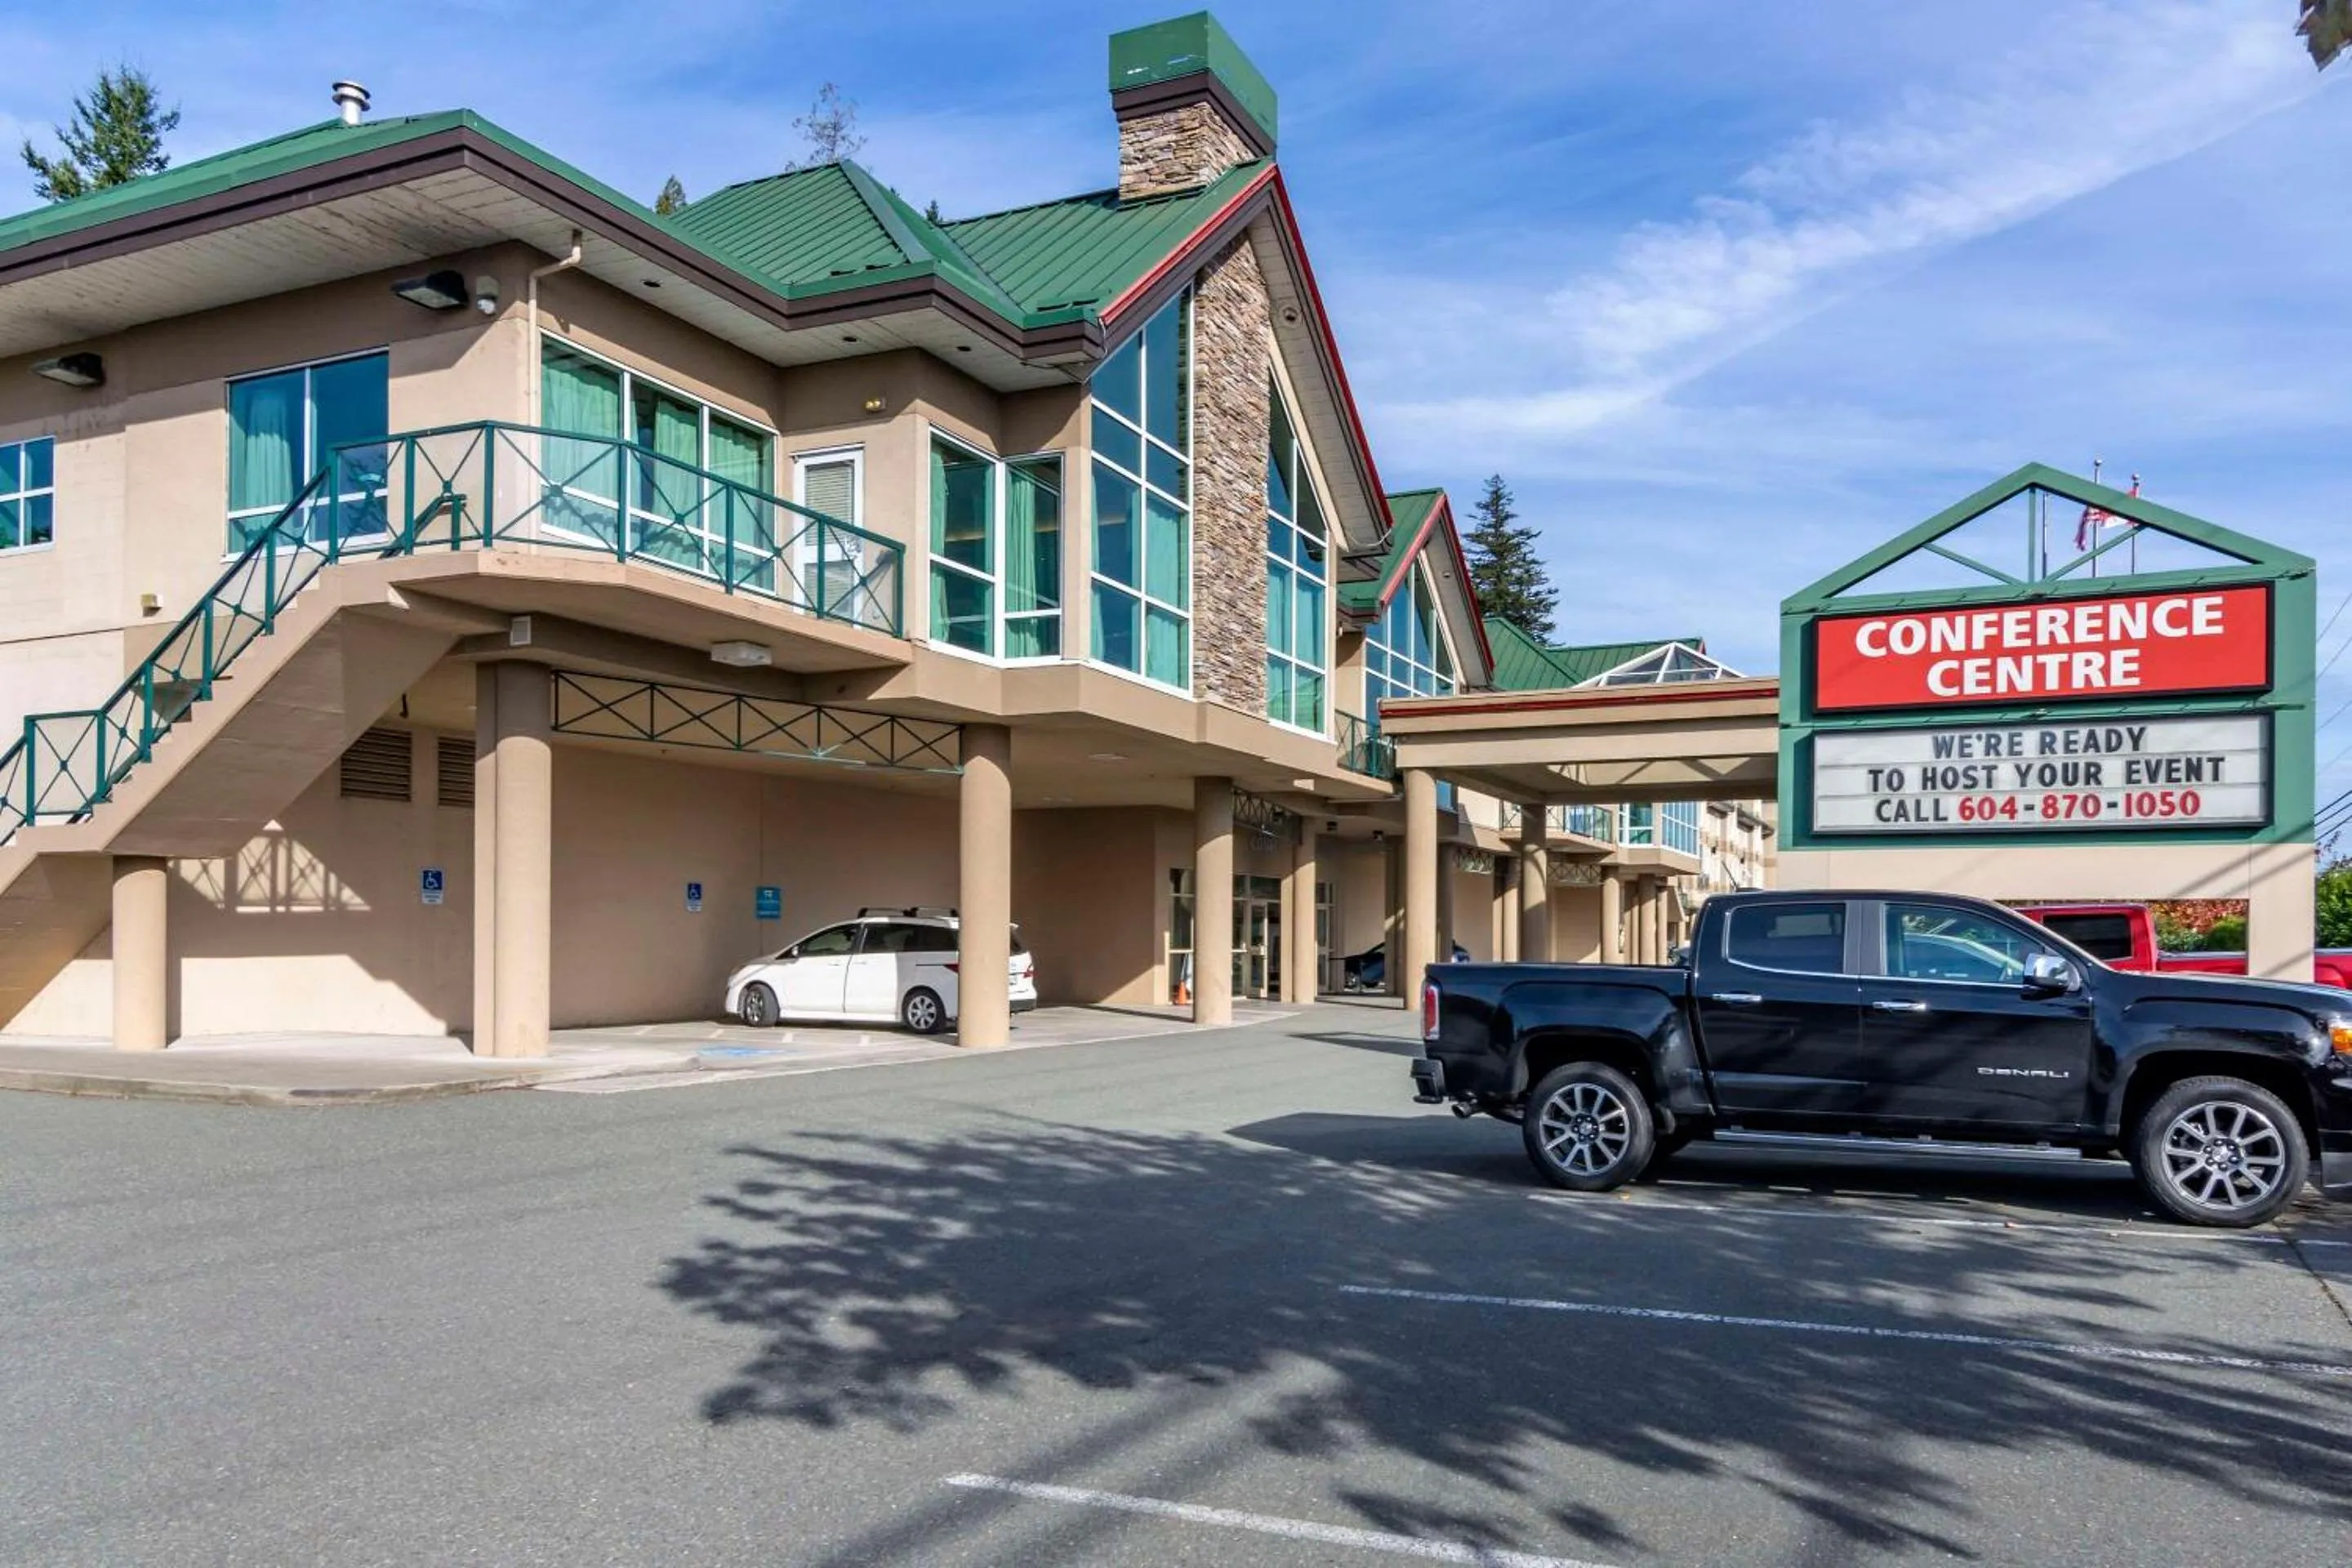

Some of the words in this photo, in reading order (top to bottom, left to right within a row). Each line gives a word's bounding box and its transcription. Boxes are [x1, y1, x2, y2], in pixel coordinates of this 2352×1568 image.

[1855, 596, 2224, 657] CONFERENCE
[1927, 648, 2140, 697] CENTRE
[1932, 732, 2023, 759] WE'RE
[2040, 727, 2146, 755] READY
[1869, 768, 1904, 792] TO
[1922, 764, 1998, 791] HOST
[2015, 762, 2102, 788] YOUR
[2126, 756, 2225, 784] EVENT
[1876, 799, 1949, 822] CALL
[1959, 789, 2201, 822] 604-870-1050
[1977, 1067, 2069, 1078] DENALI
